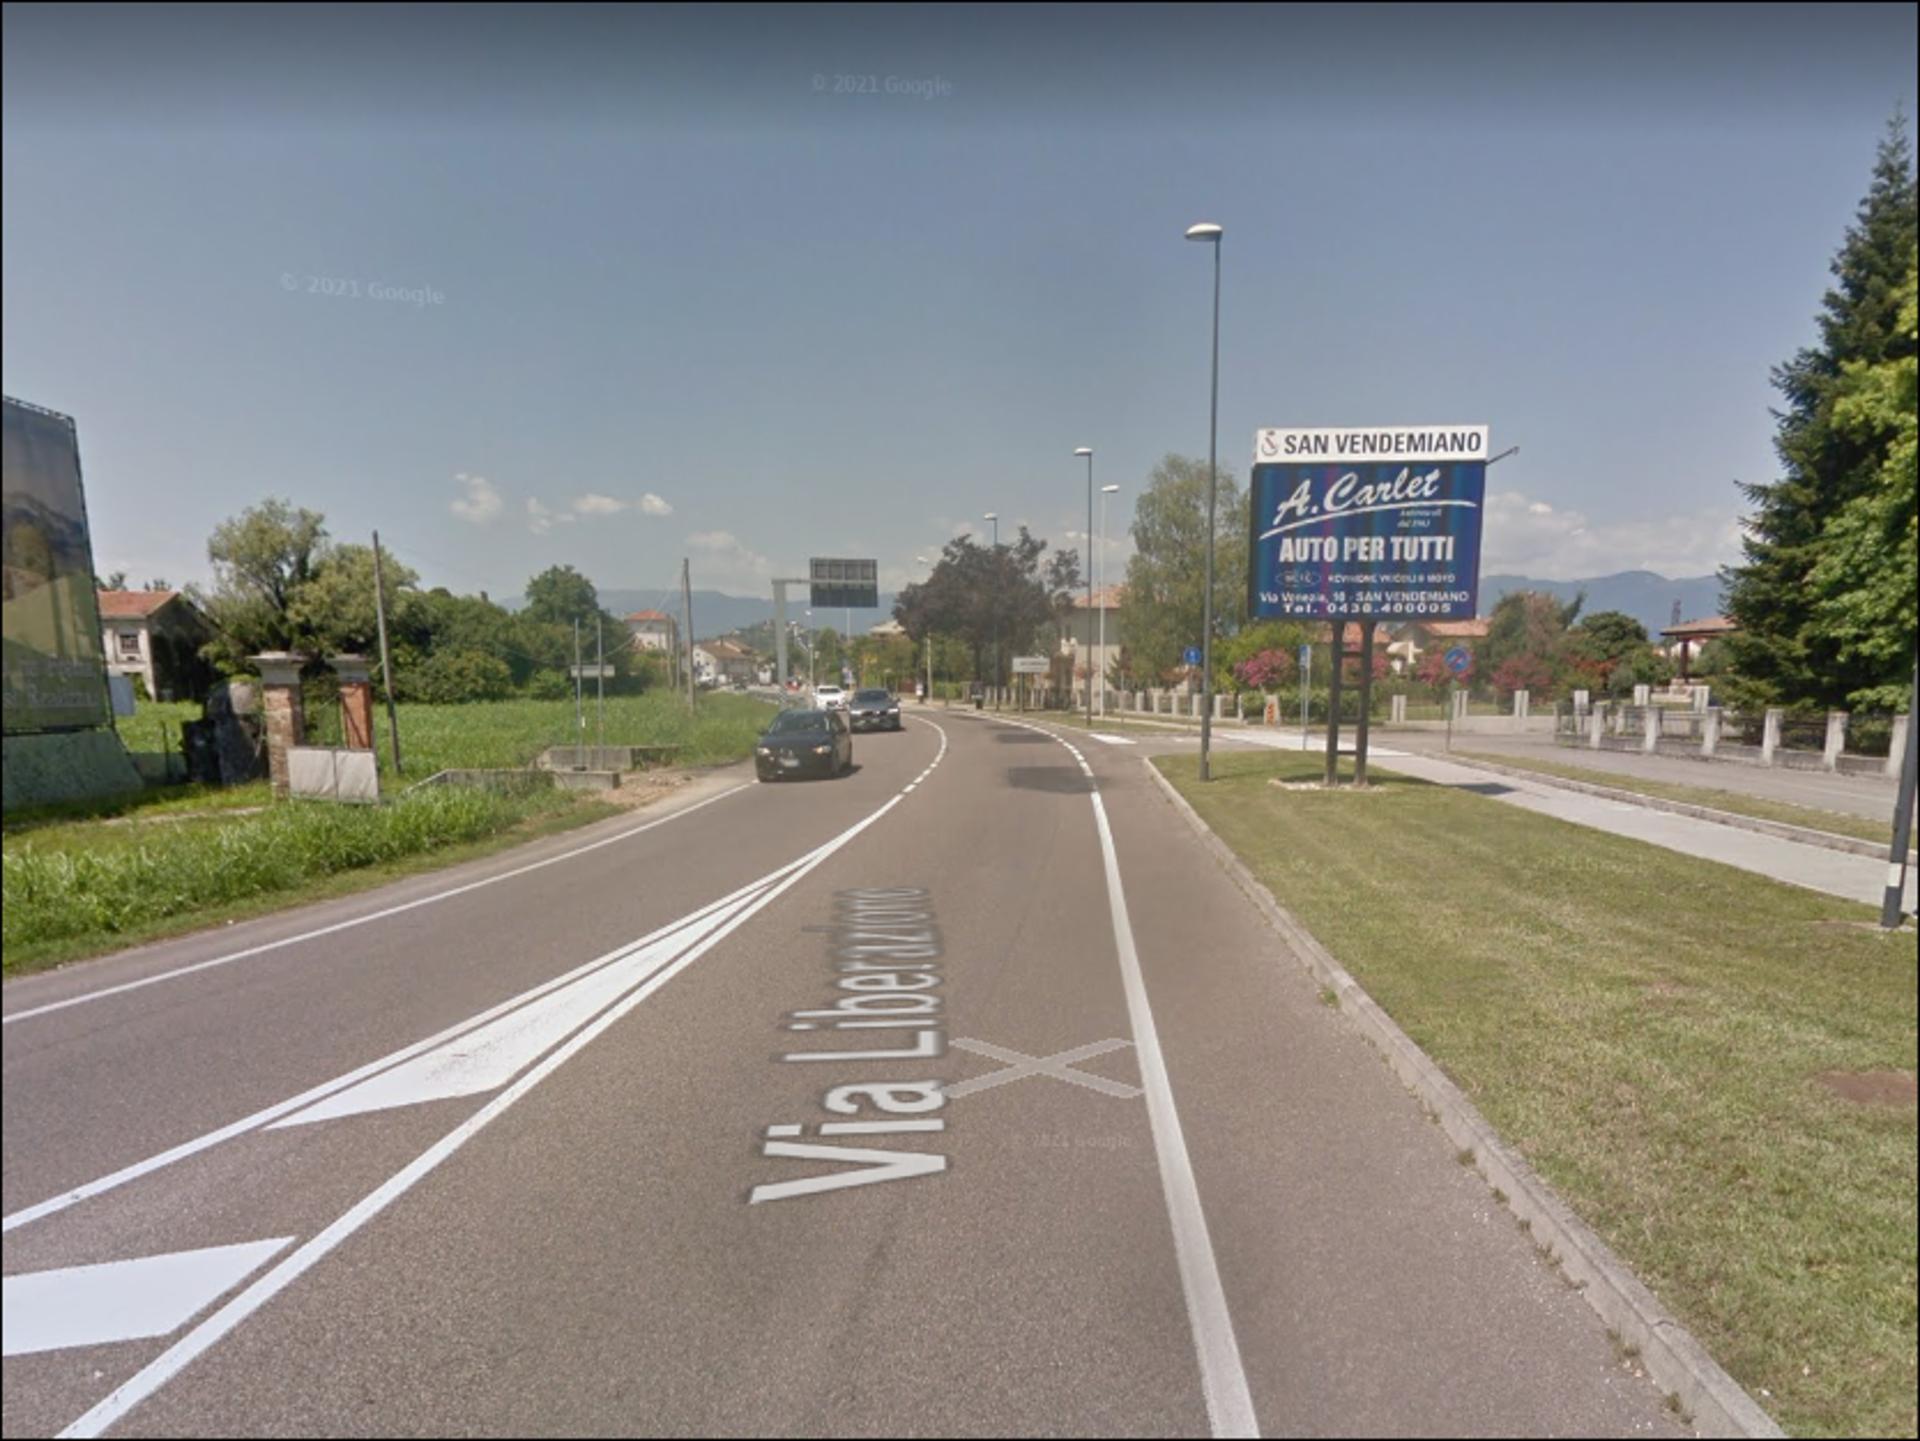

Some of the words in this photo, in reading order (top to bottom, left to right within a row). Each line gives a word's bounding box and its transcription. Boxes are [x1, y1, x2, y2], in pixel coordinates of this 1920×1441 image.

[1284, 434, 1329, 454] SAN
[1336, 432, 1482, 454] VENDEMIANO
[1322, 467, 1441, 511] Carlet
[1279, 536, 1338, 562] AUTO
[1343, 536, 1385, 562] PER
[1390, 536, 1455, 561] TUTTI
[1260, 592, 1278, 604] Via
[1356, 592, 1382, 602] SAN
[1385, 591, 1469, 601] VENDEMIANO
